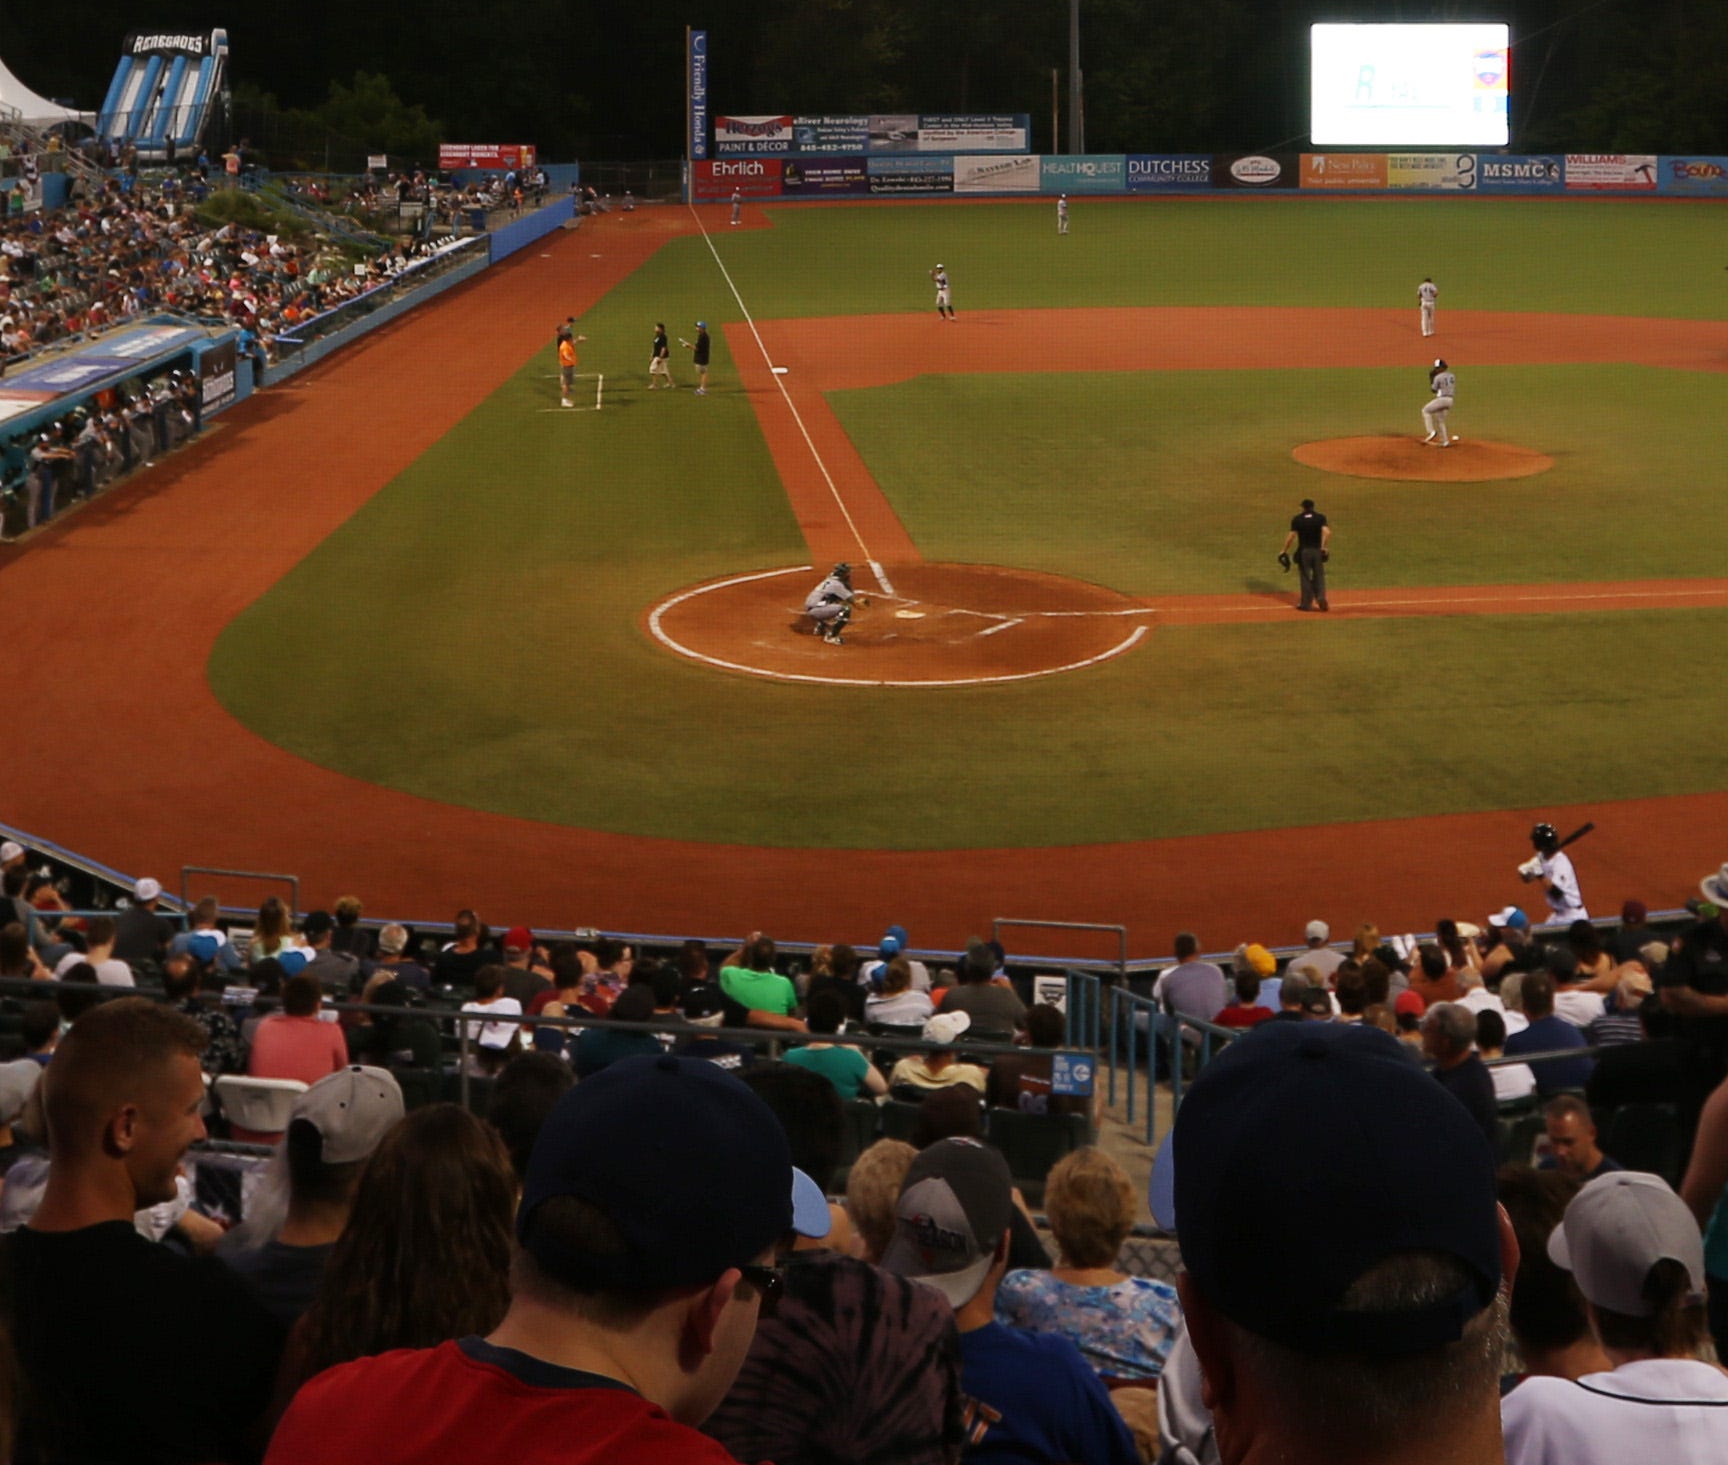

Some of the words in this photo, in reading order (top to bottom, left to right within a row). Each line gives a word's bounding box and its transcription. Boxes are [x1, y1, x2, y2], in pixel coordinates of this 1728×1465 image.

[133, 35, 202, 53] RENEGADES
[692, 55, 705, 99] Friendly
[694, 106, 705, 143] Honda
[719, 143, 746, 152] PAINT
[1567, 155, 1626, 164] WILLIAMS
[713, 161, 764, 177] Ehrlich
[1043, 162, 1121, 176] HEALTHQUEST
[1129, 160, 1210, 174] DUTCHESS
[1483, 163, 1544, 177] MSMC
[1129, 175, 1175, 183] COMMUNITY
[1177, 175, 1209, 183] COLLEGE
